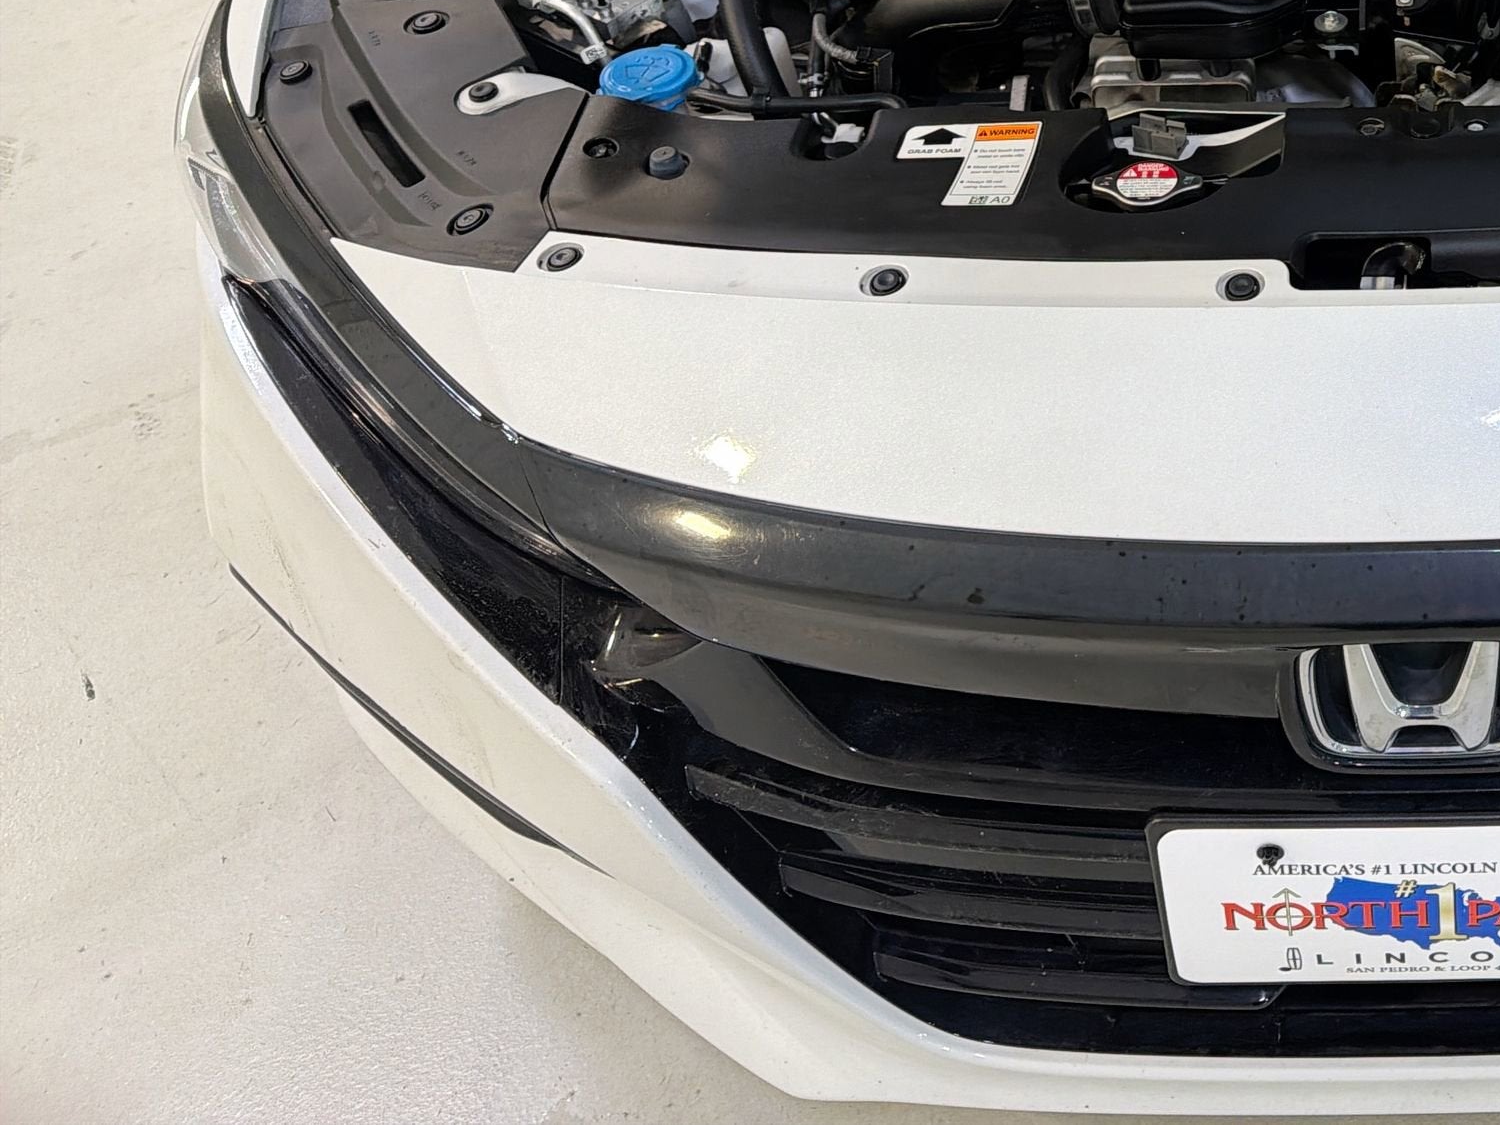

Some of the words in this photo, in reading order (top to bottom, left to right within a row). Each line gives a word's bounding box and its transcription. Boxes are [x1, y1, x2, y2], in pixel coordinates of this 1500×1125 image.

[989, 127, 1036, 137] WARNING
[1252, 863, 1366, 876] AMERICA'S
[1371, 864, 1393, 875] #1
[1400, 861, 1498, 875] LINCOLN
[1220, 899, 1431, 931] NORTH
[1346, 966, 1375, 974] SAN
